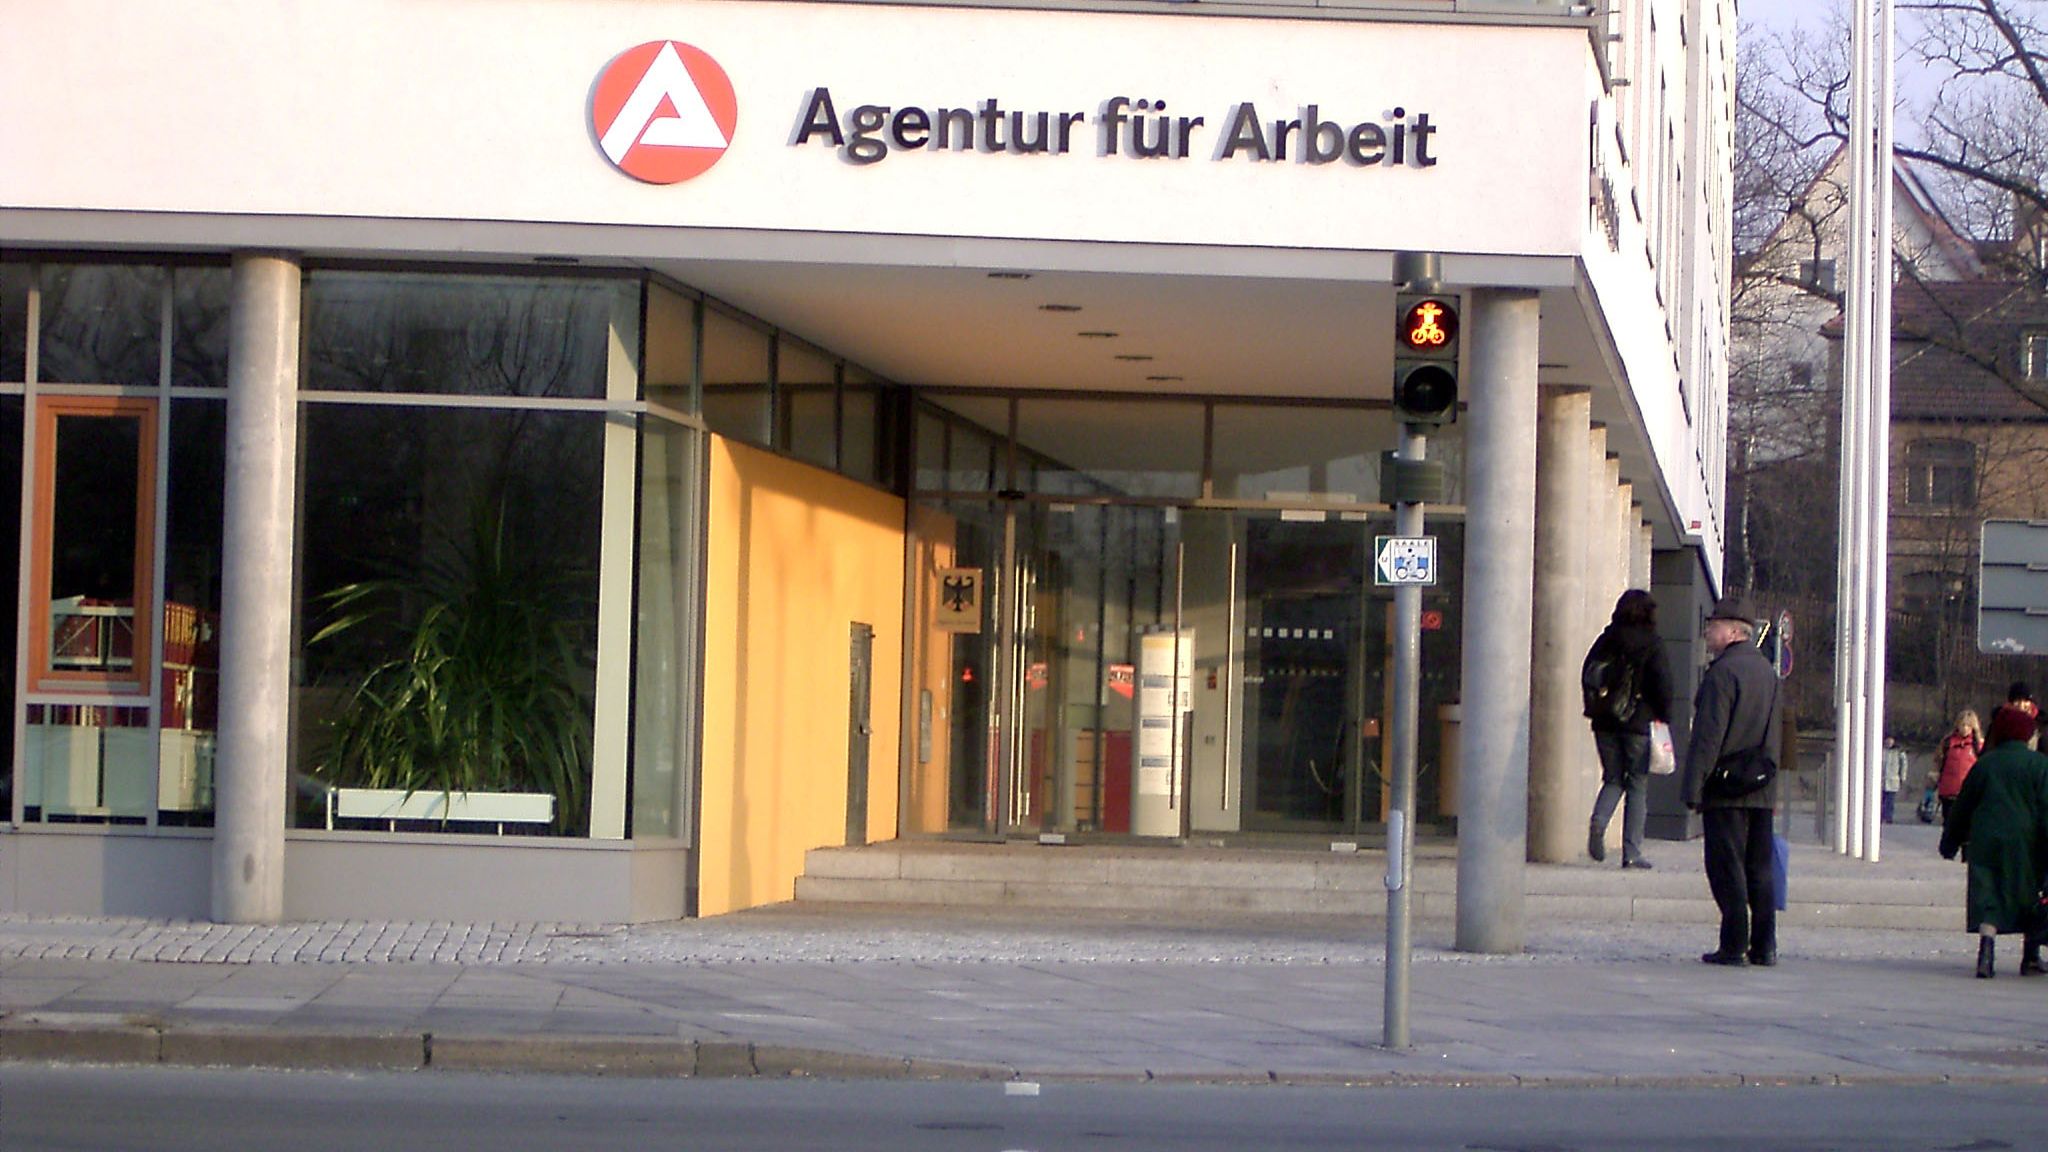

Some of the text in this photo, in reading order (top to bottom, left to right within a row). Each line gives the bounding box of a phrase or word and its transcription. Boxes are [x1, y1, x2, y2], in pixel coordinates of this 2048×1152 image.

[795, 86, 1437, 166] Agentur für Arbeit
